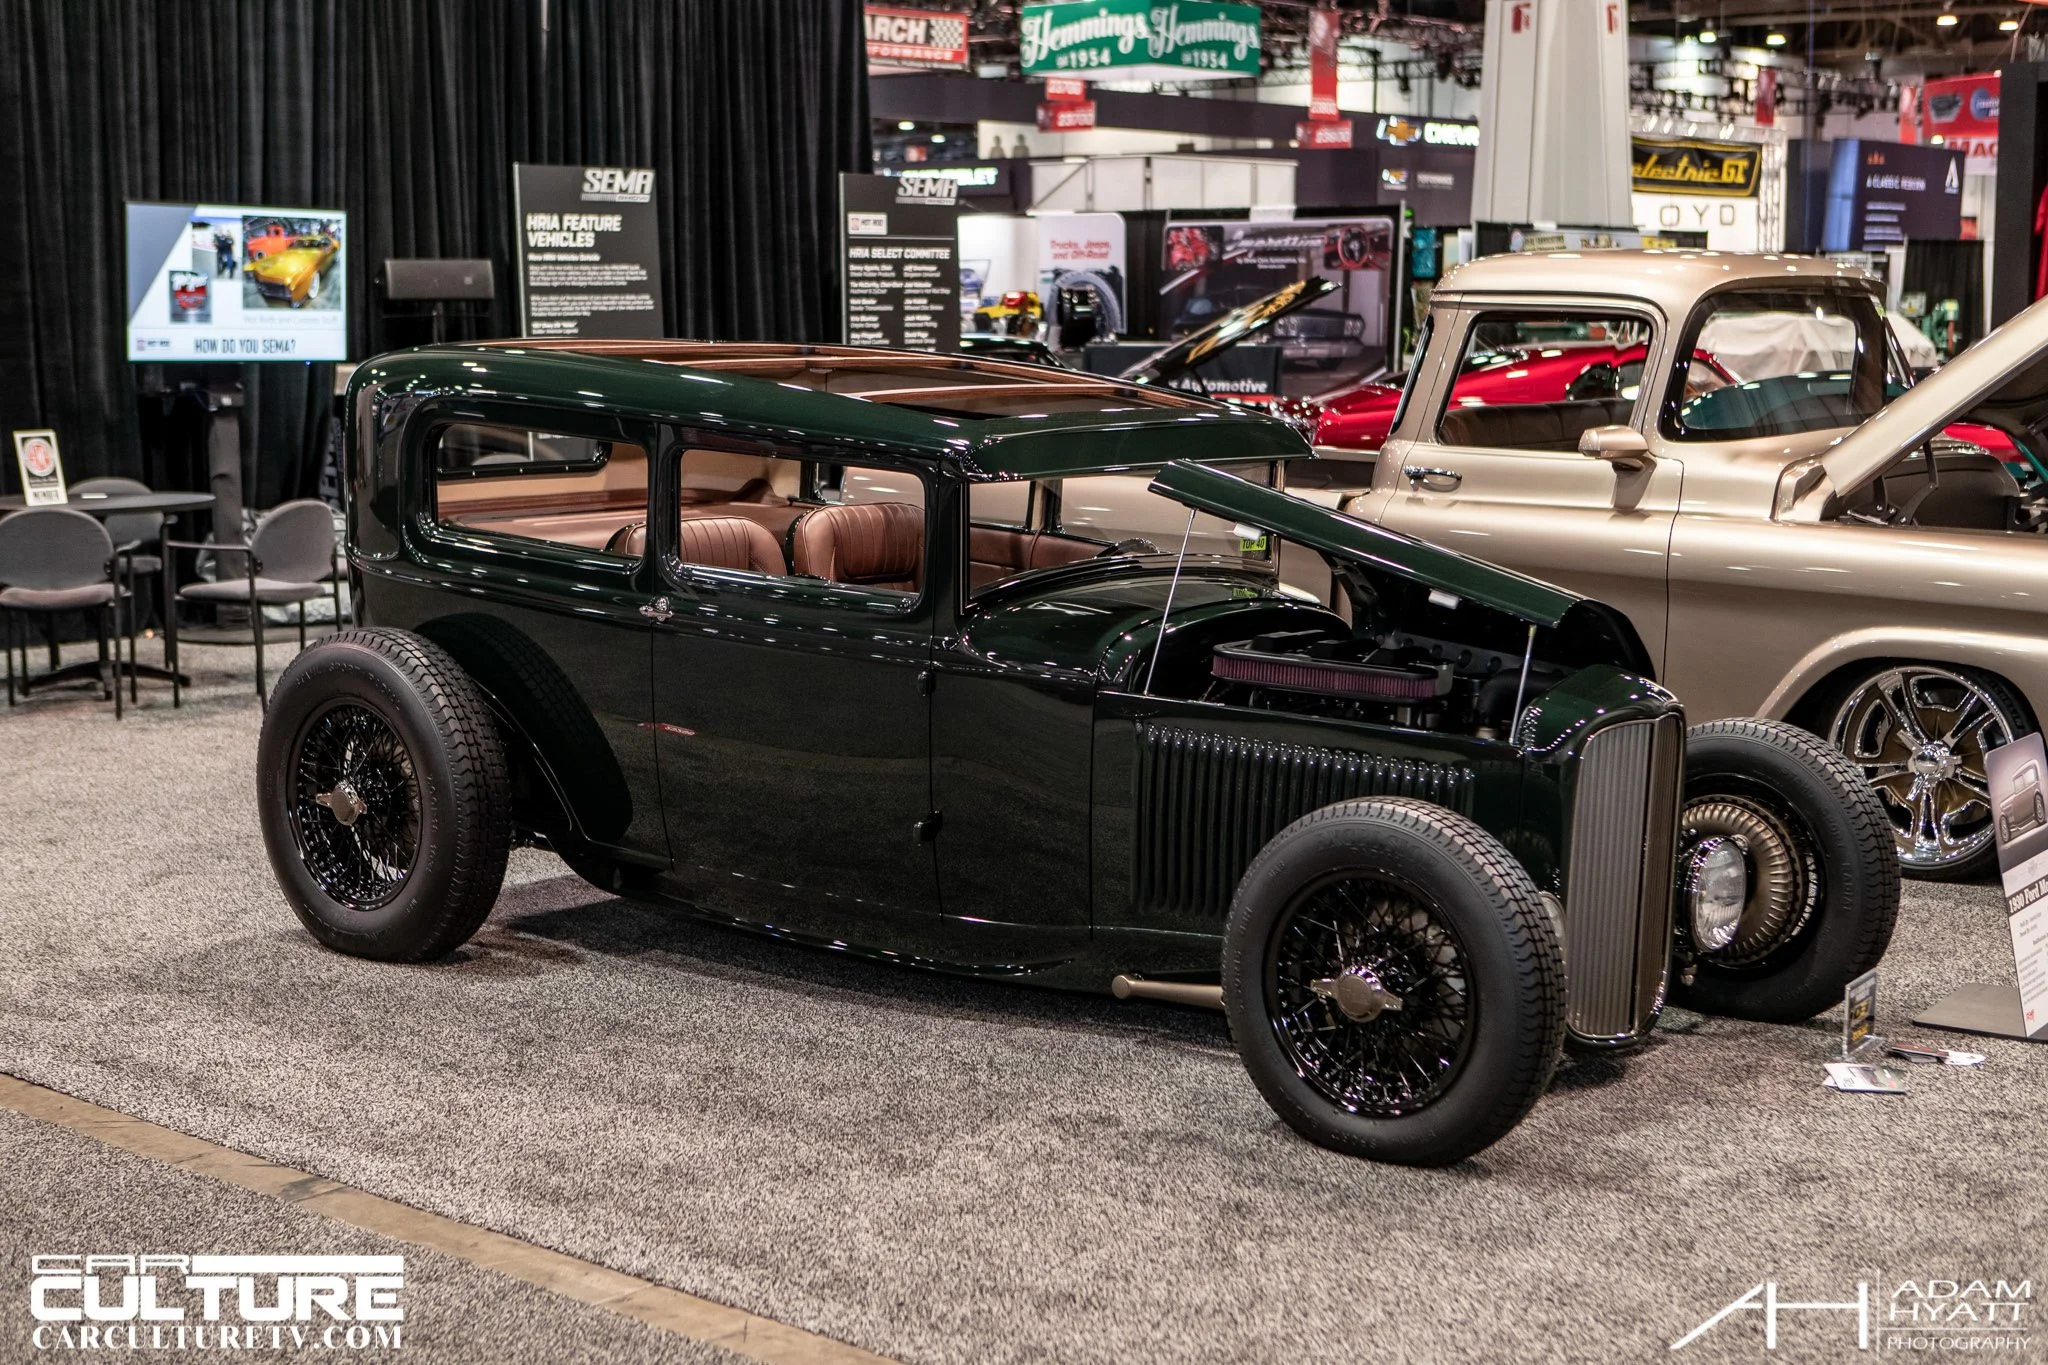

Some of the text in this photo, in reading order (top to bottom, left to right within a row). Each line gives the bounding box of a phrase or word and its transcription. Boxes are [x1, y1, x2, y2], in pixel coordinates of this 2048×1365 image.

[1021, 8, 1150, 67] Hemmings
[1148, 4, 1260, 61] Hemmings
[1070, 47, 1111, 68] 1954
[1193, 49, 1229, 69] 1954
[583, 168, 655, 194] SEMA
[527, 213, 622, 231] HRIA FEATURE
[1660, 204, 1735, 226] OYO
[527, 231, 596, 248] VEHICLES
[849, 247, 951, 260] HRIA SELECT COMMITTEE
[195, 338, 296, 354] HOW DO YOU SEMA?
[2009, 893, 2025, 914] 1930
[2024, 882, 2040, 905] Ford
